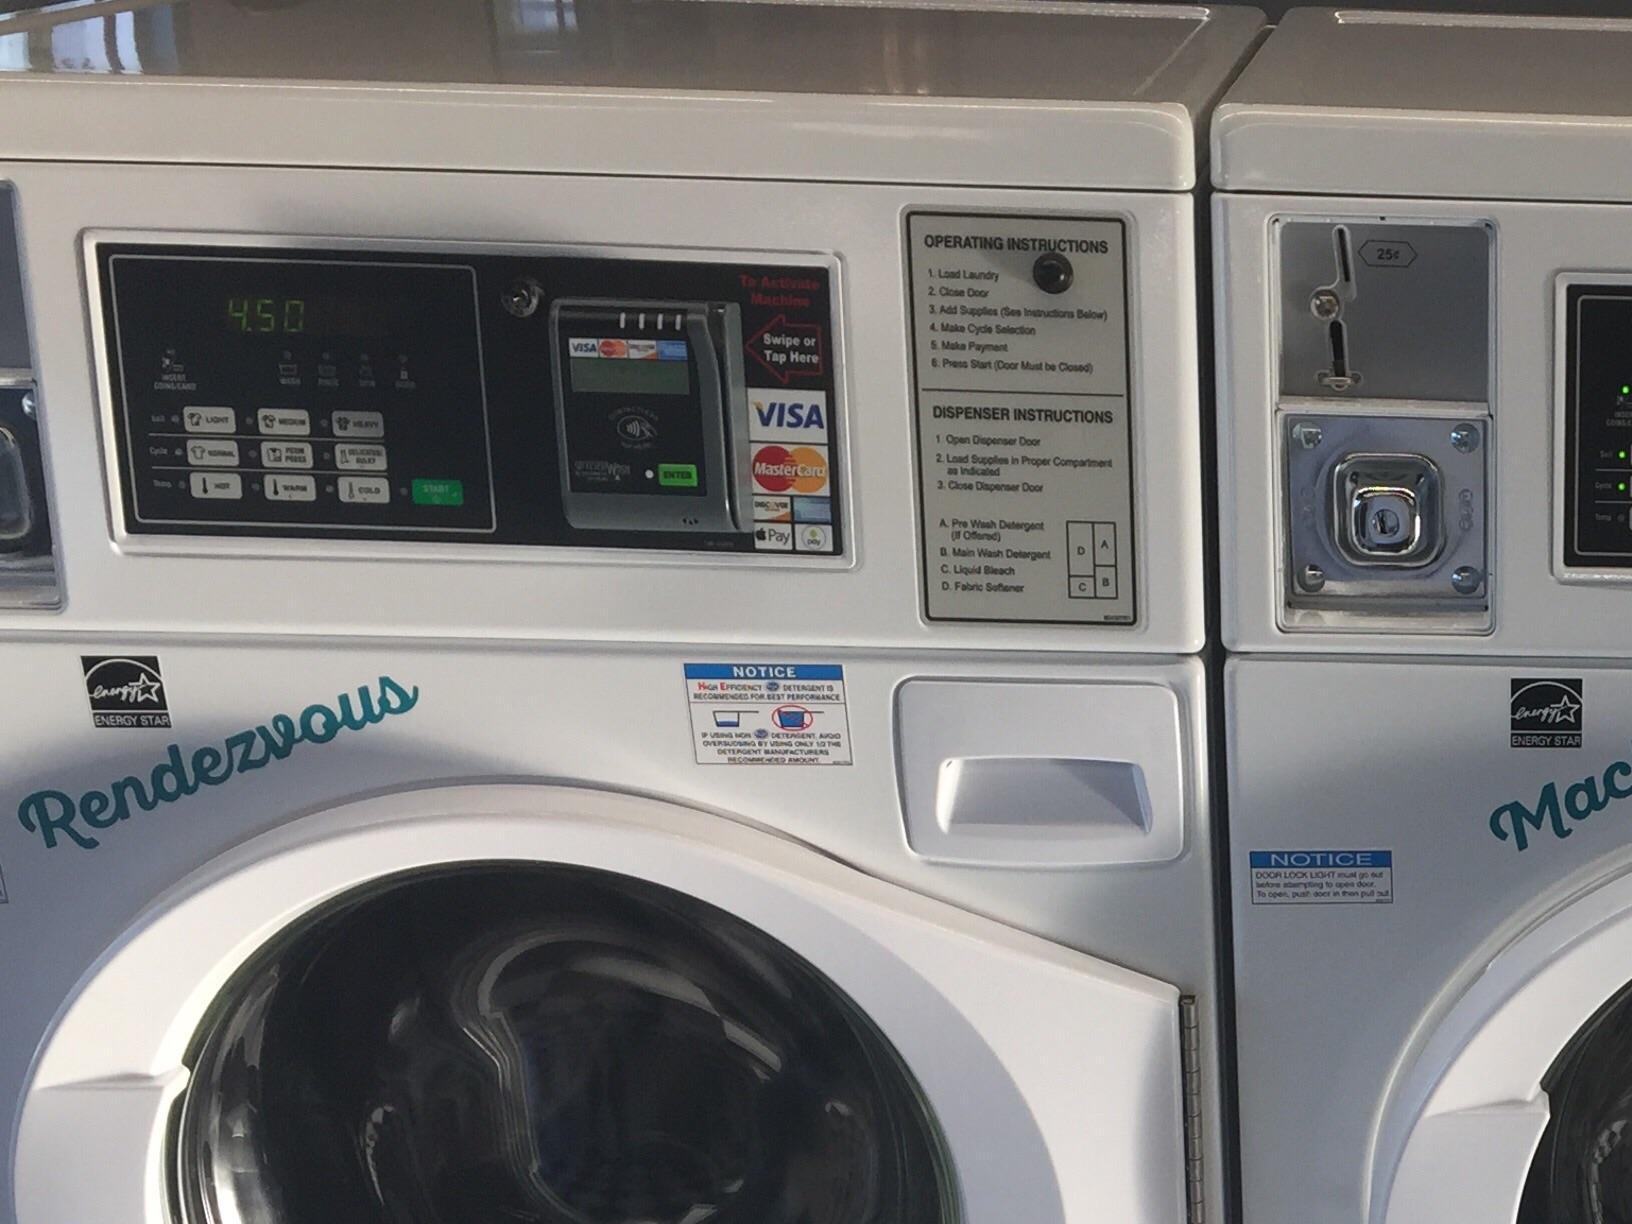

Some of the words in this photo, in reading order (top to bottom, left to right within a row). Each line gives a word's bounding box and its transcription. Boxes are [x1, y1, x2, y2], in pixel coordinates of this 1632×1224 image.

[924, 235, 1003, 250] OPERATING
[1008, 237, 1108, 253] INSTRUCTIONS
[938, 270, 960, 279] Load
[963, 270, 999, 281] Laundry
[929, 288, 936, 296] 2.
[940, 288, 965, 297] Close
[968, 289, 988, 297] Door
[228, 300, 304, 332] 4.50
[929, 305, 937, 314] 3.
[940, 305, 957, 315] Add
[960, 306, 998, 318] Supplies
[1001, 307, 1021, 318] (See
[1024, 308, 1074, 319] Instructions
[1077, 309, 1107, 320] Below)
[930, 323, 938, 332] 4.
[941, 323, 965, 333] Make
[968, 324, 992, 335] Cycle
[995, 325, 1035, 335] Selection
[763, 333, 800, 347] Swipe
[804, 336, 816, 346] or
[572, 343, 597, 353] VISA
[942, 341, 966, 351] Make
[968, 342, 1008, 353] Payment
[764, 350, 786, 365] Tap
[790, 351, 819, 363] Here
[942, 359, 968, 369] Press
[971, 360, 991, 369] Start
[995, 360, 1018, 371] (Door
[1021, 361, 1042, 371] Must
[1045, 362, 1056, 371] be
[1059, 362, 1093, 373] Closed)
[753, 401, 825, 430] VISA
[933, 406, 1009, 420] DISPENSER
[1014, 408, 1113, 423] INSTRUCTIONS
[946, 435, 970, 445] Open
[973, 436, 1017, 447] Dispenser
[1019, 437, 1040, 446] Door
[937, 454, 944, 463] 2.
[946, 454, 968, 464] Load
[971, 455, 1008, 467] Supplies
[1011, 456, 1019, 465] in
[1021, 456, 1050, 468] Proper
[1053, 457, 1112, 469] Compartment
[663, 470, 692, 479] ENTER
[754, 462, 826, 477] MasterCard
[961, 466, 1000, 476] Indicated
[948, 482, 973, 491] Close
[976, 482, 1019, 493] Dispenser
[1022, 483, 1043, 492] Door
[940, 520, 948, 528] A.
[952, 520, 968, 529] Pre
[971, 520, 996, 529] Wash
[1000, 520, 1044, 532] Detergent
[769, 529, 790, 545] Pay
[963, 531, 1001, 542] Offered)
[1101, 540, 1108, 549] A
[953, 548, 975, 558] Main
[978, 549, 1003, 558] Wash
[1006, 550, 1051, 561] Detergent
[1077, 547, 1085, 555] D
[954, 565, 981, 576] Liquid
[984, 566, 1015, 576] Bleach
[955, 582, 983, 592] Fabric
[986, 583, 1024, 592] Softener
[1079, 583, 1086, 591] C
[1103, 578, 1109, 586] B
[732, 666, 796, 678] NOTICE
[89, 683, 139, 703] energy
[95, 714, 138, 726] ENERGY
[140, 714, 171, 726] STAR
[1515, 706, 1558, 722] energy
[1512, 736, 1552, 747] ENERGY
[1555, 736, 1582, 747] STAR
[18, 676, 419, 849] Rendezvous
[1271, 853, 1372, 866] NOTICE
[1256, 871, 1281, 879] DOOR
